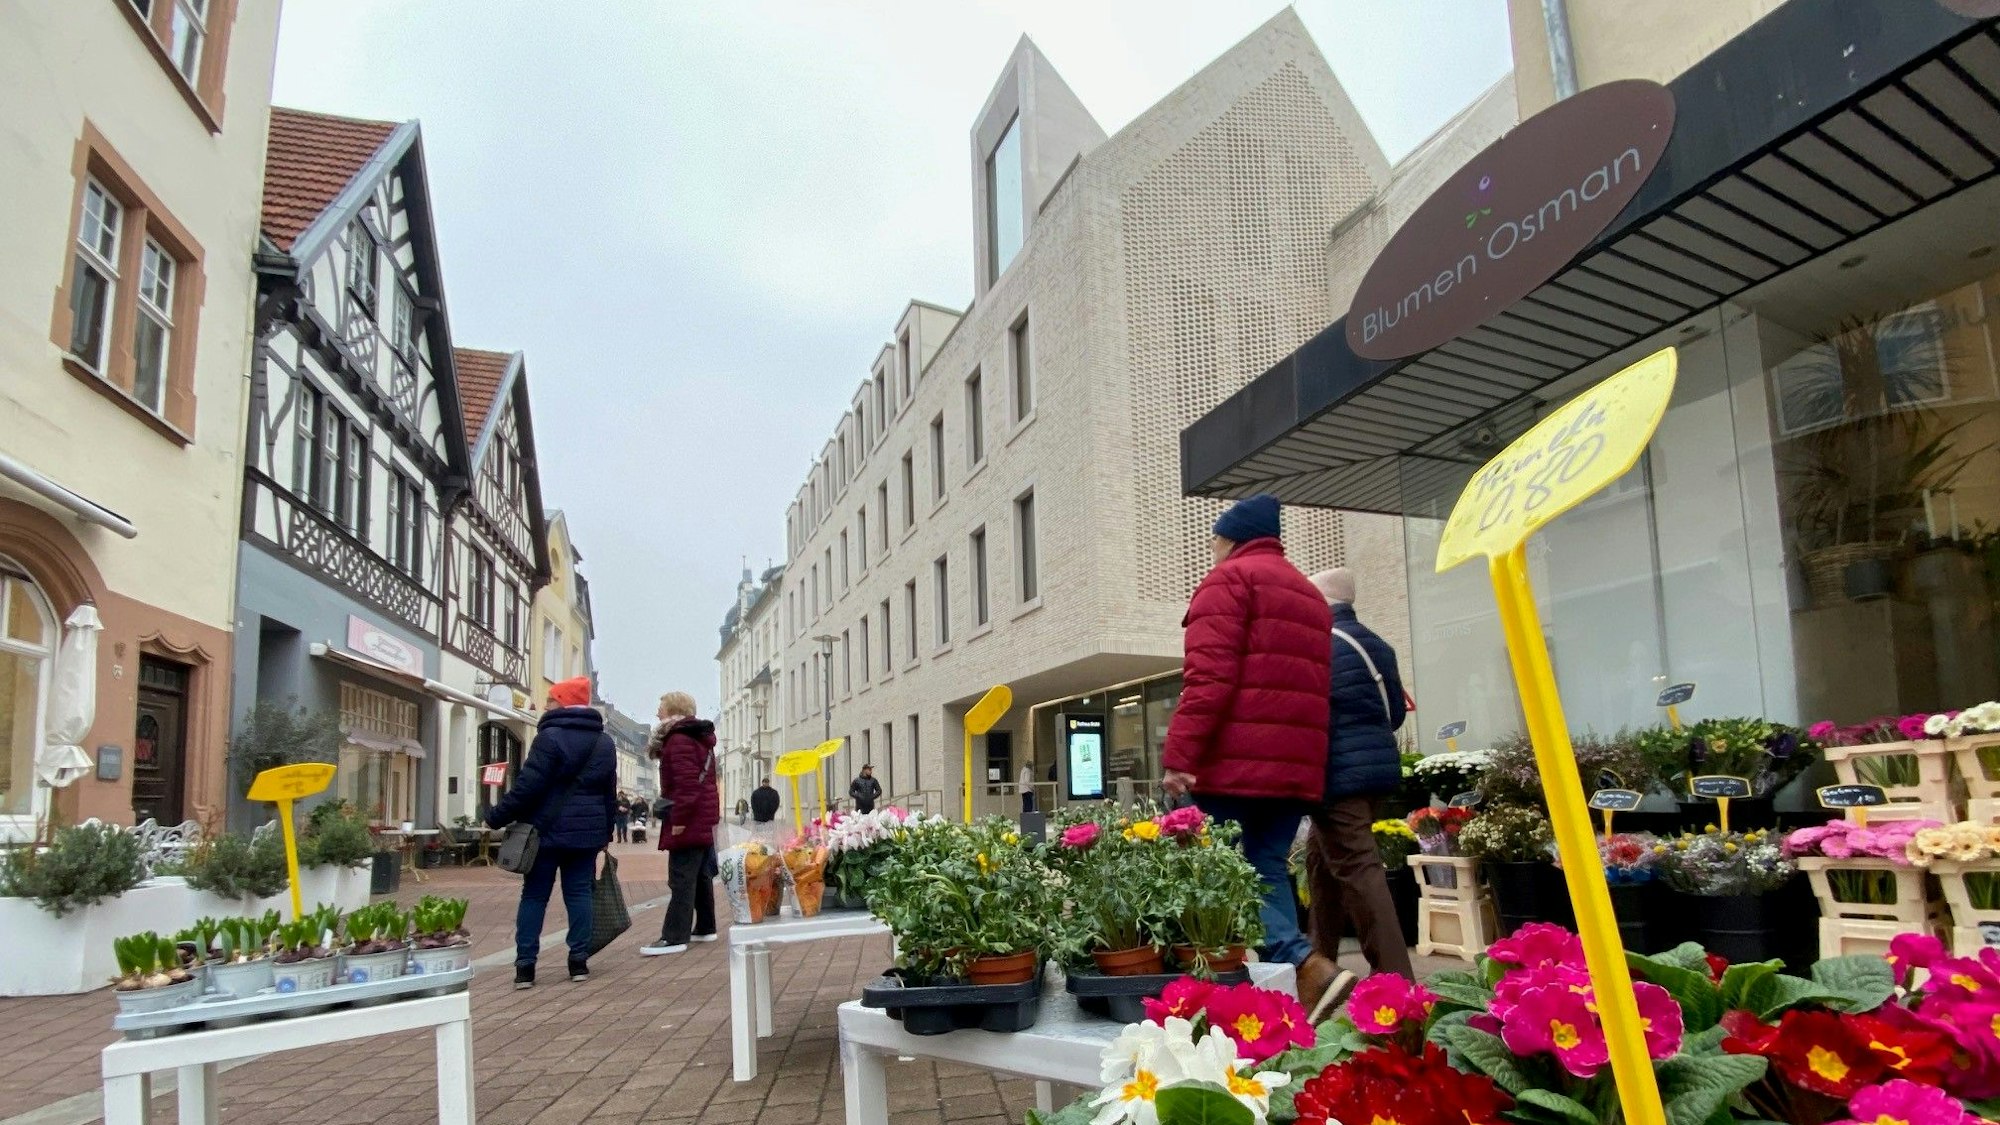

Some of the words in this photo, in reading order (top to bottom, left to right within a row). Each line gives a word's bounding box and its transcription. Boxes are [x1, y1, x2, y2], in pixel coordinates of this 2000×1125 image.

[1361, 252, 1477, 345] Blumen
[1486, 146, 1641, 260] Osman
[1479, 431, 1606, 531] 0,80
[484, 766, 506, 783] Bild
